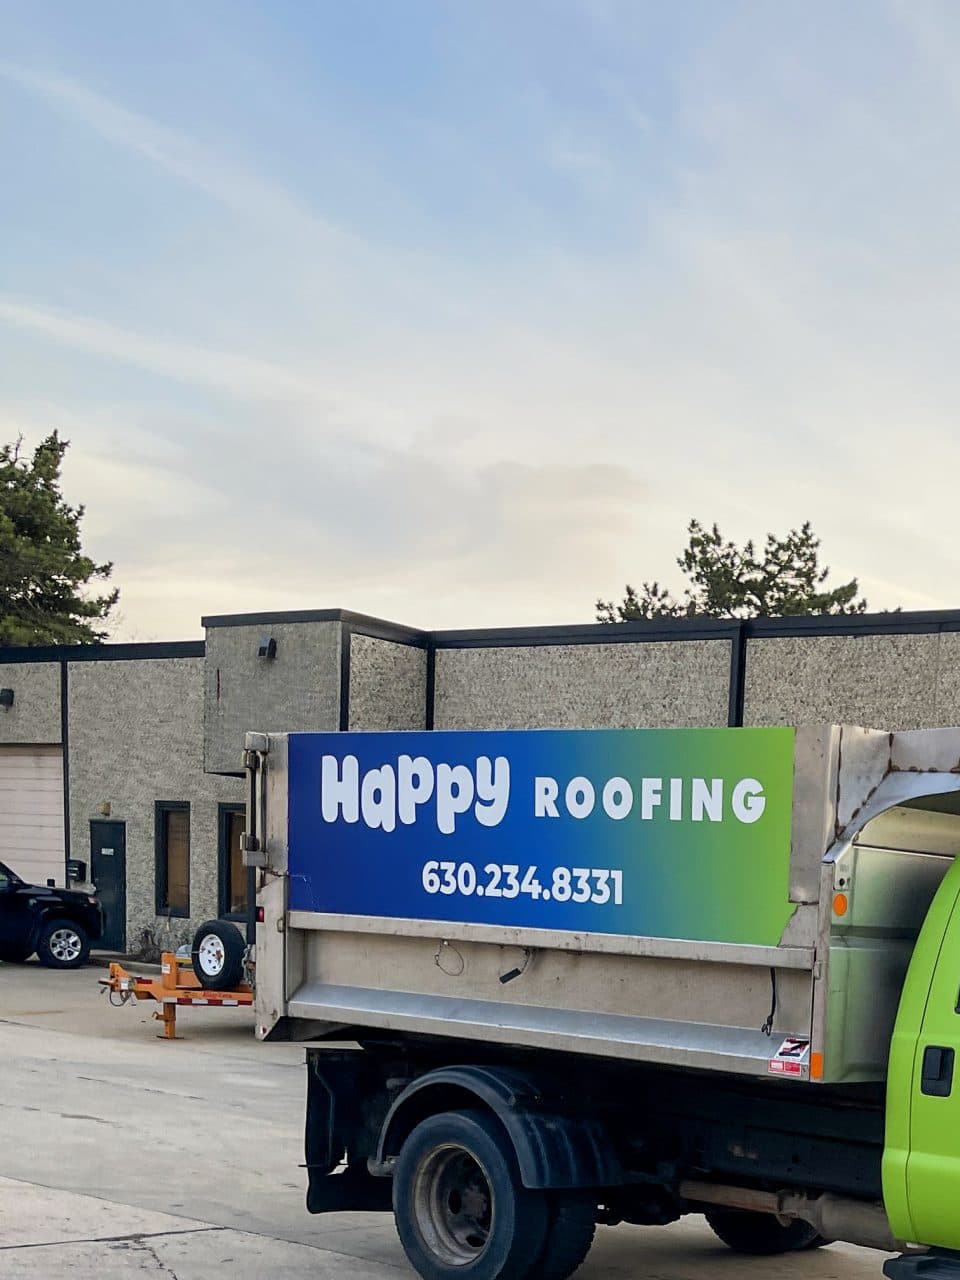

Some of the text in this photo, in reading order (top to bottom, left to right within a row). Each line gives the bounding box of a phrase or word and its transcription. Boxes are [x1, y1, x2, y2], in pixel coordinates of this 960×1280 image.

[321, 754, 767, 835] Happy ROOFING
[422, 860, 624, 905] 630.234.8331
